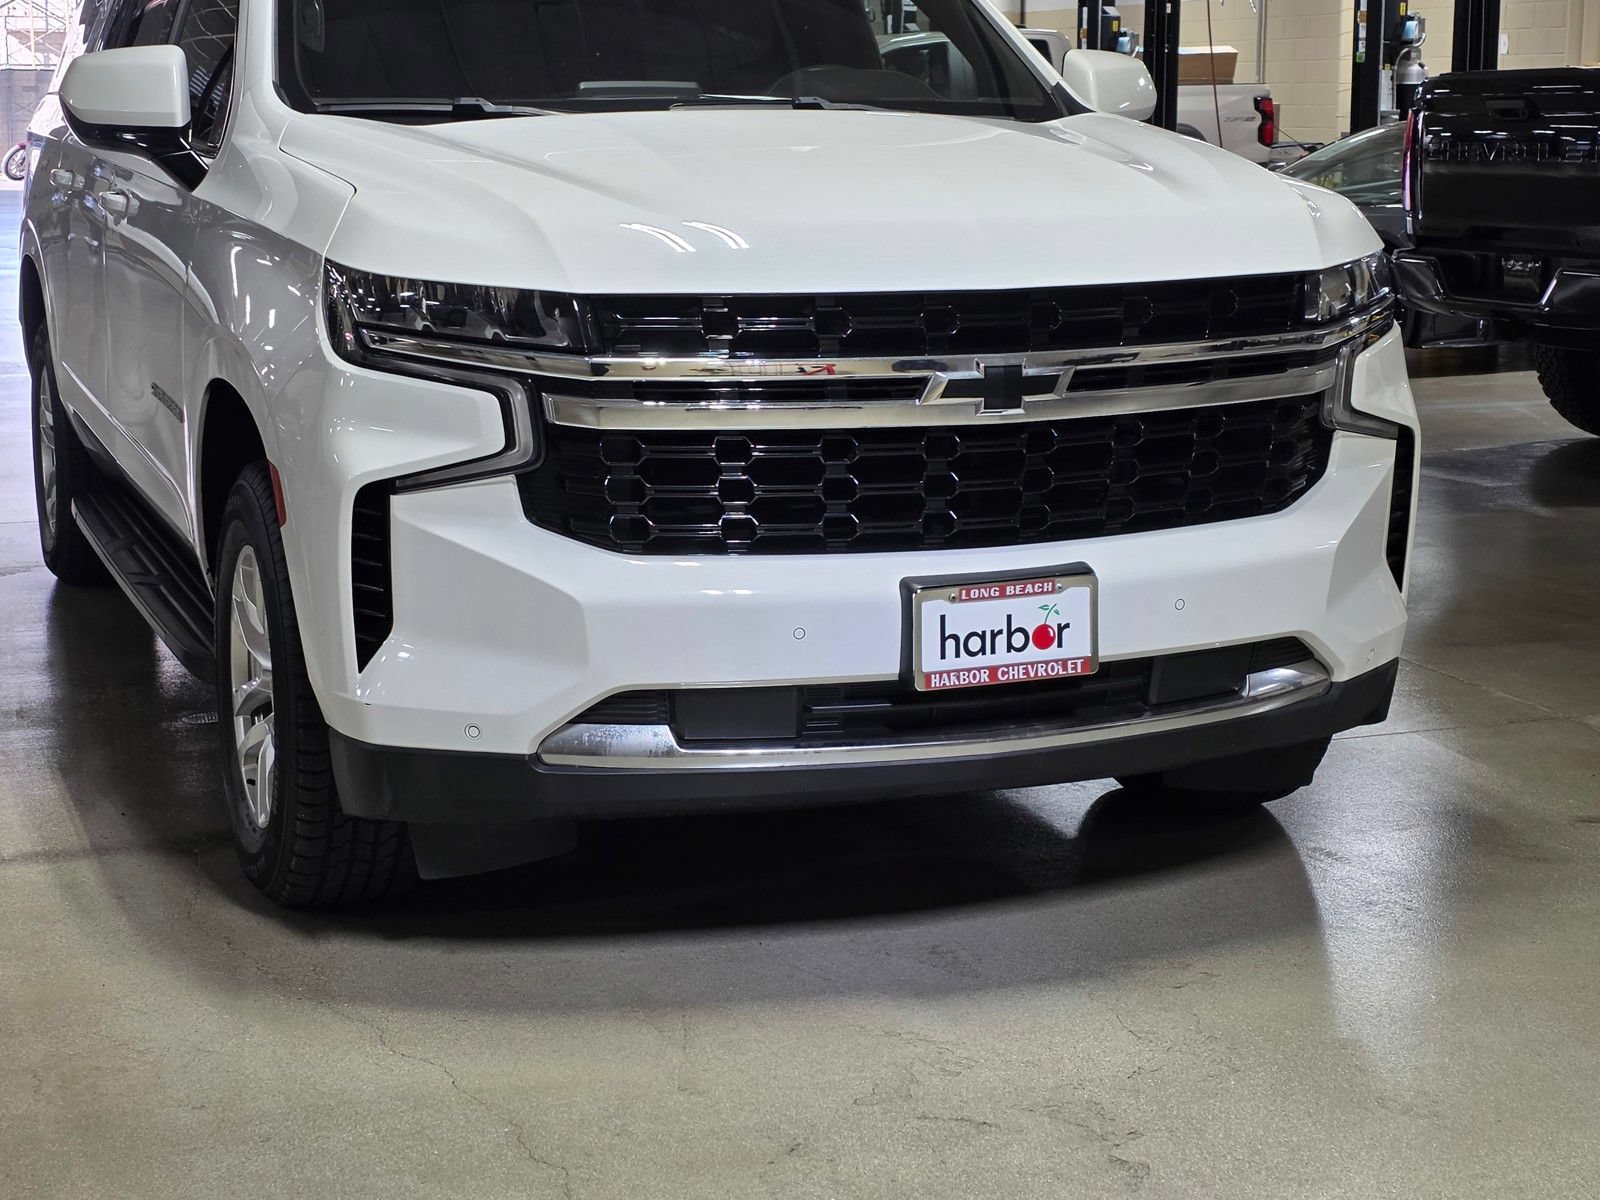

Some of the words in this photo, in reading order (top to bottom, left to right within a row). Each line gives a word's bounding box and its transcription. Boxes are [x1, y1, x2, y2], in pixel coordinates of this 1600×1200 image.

[961, 586, 1000, 600] LONG
[1006, 582, 1053, 596] BEACH
[931, 670, 990, 688] HARBOR
[997, 659, 1084, 681] CHEVROLET
